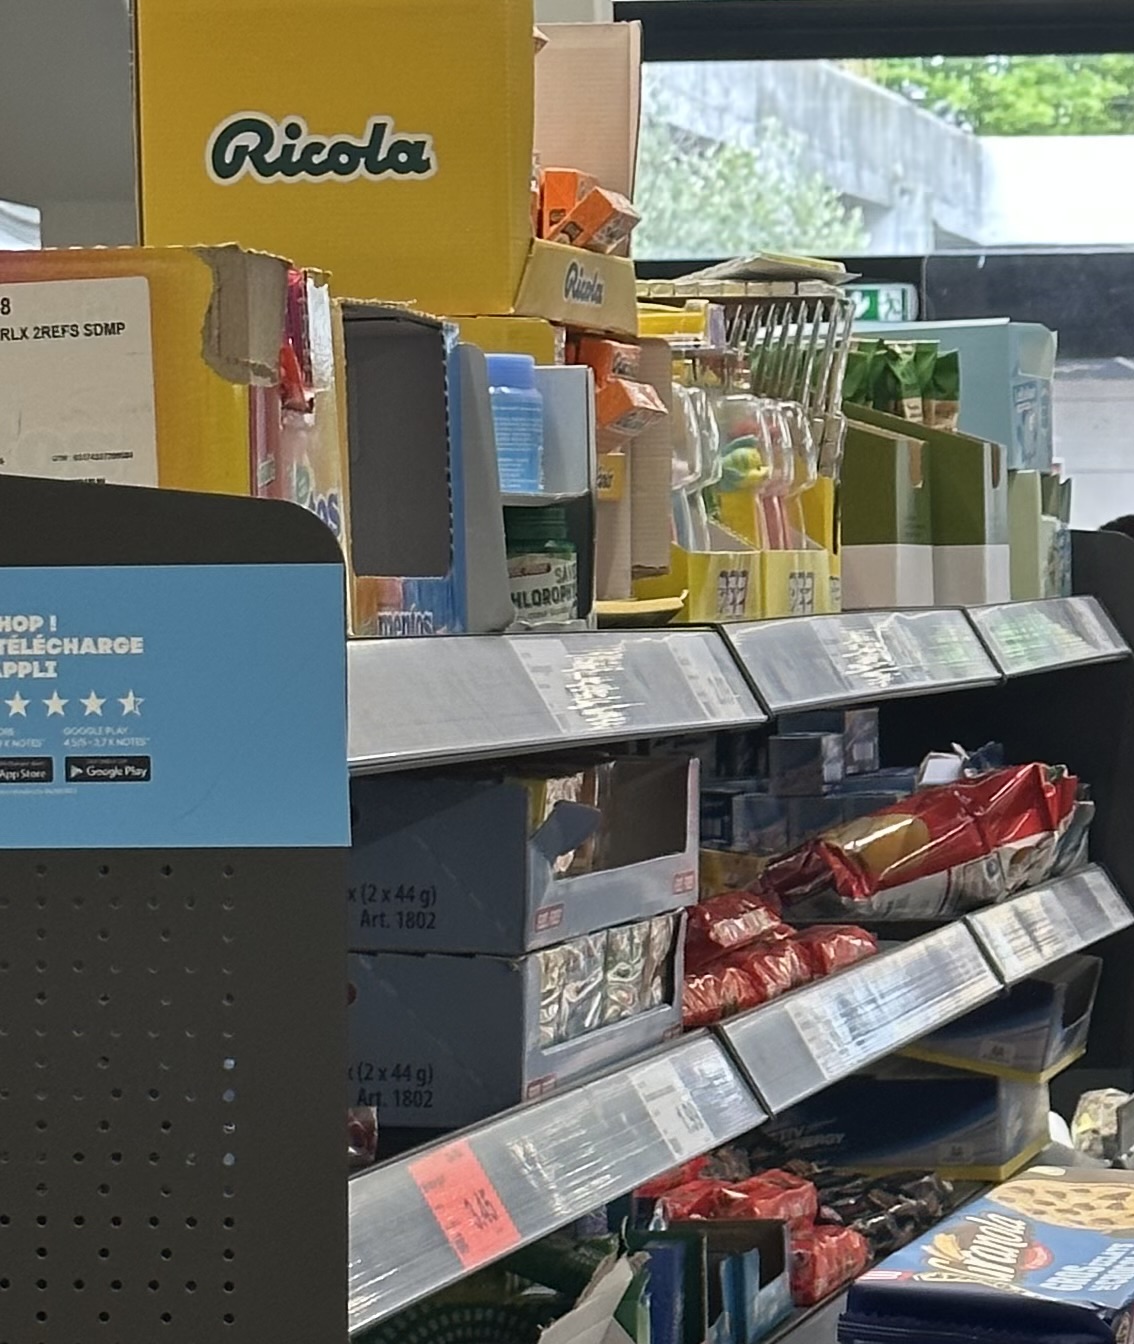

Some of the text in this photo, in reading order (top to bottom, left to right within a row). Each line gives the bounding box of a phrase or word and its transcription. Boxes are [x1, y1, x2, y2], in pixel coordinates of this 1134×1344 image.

[212, 118, 431, 179] Ricola
[0, 297, 11, 315] 8
[84, 322, 126, 337] SDMP
[0, 635, 144, 655] TÉLÉCHARGE
[0, 661, 57, 678] PPLI
[86, 765, 147, 779] Google Play
[361, 884, 378, 904] (2
[382, 887, 391, 900] x
[395, 885, 416, 902] 44
[420, 885, 437, 908] g)
[360, 910, 436, 929] Art. 1802
[357, 1062, 434, 1087] (2 x 44 g)
[357, 1088, 434, 1108] Art. 1802
[1040, 1264, 1105, 1291] GROS
